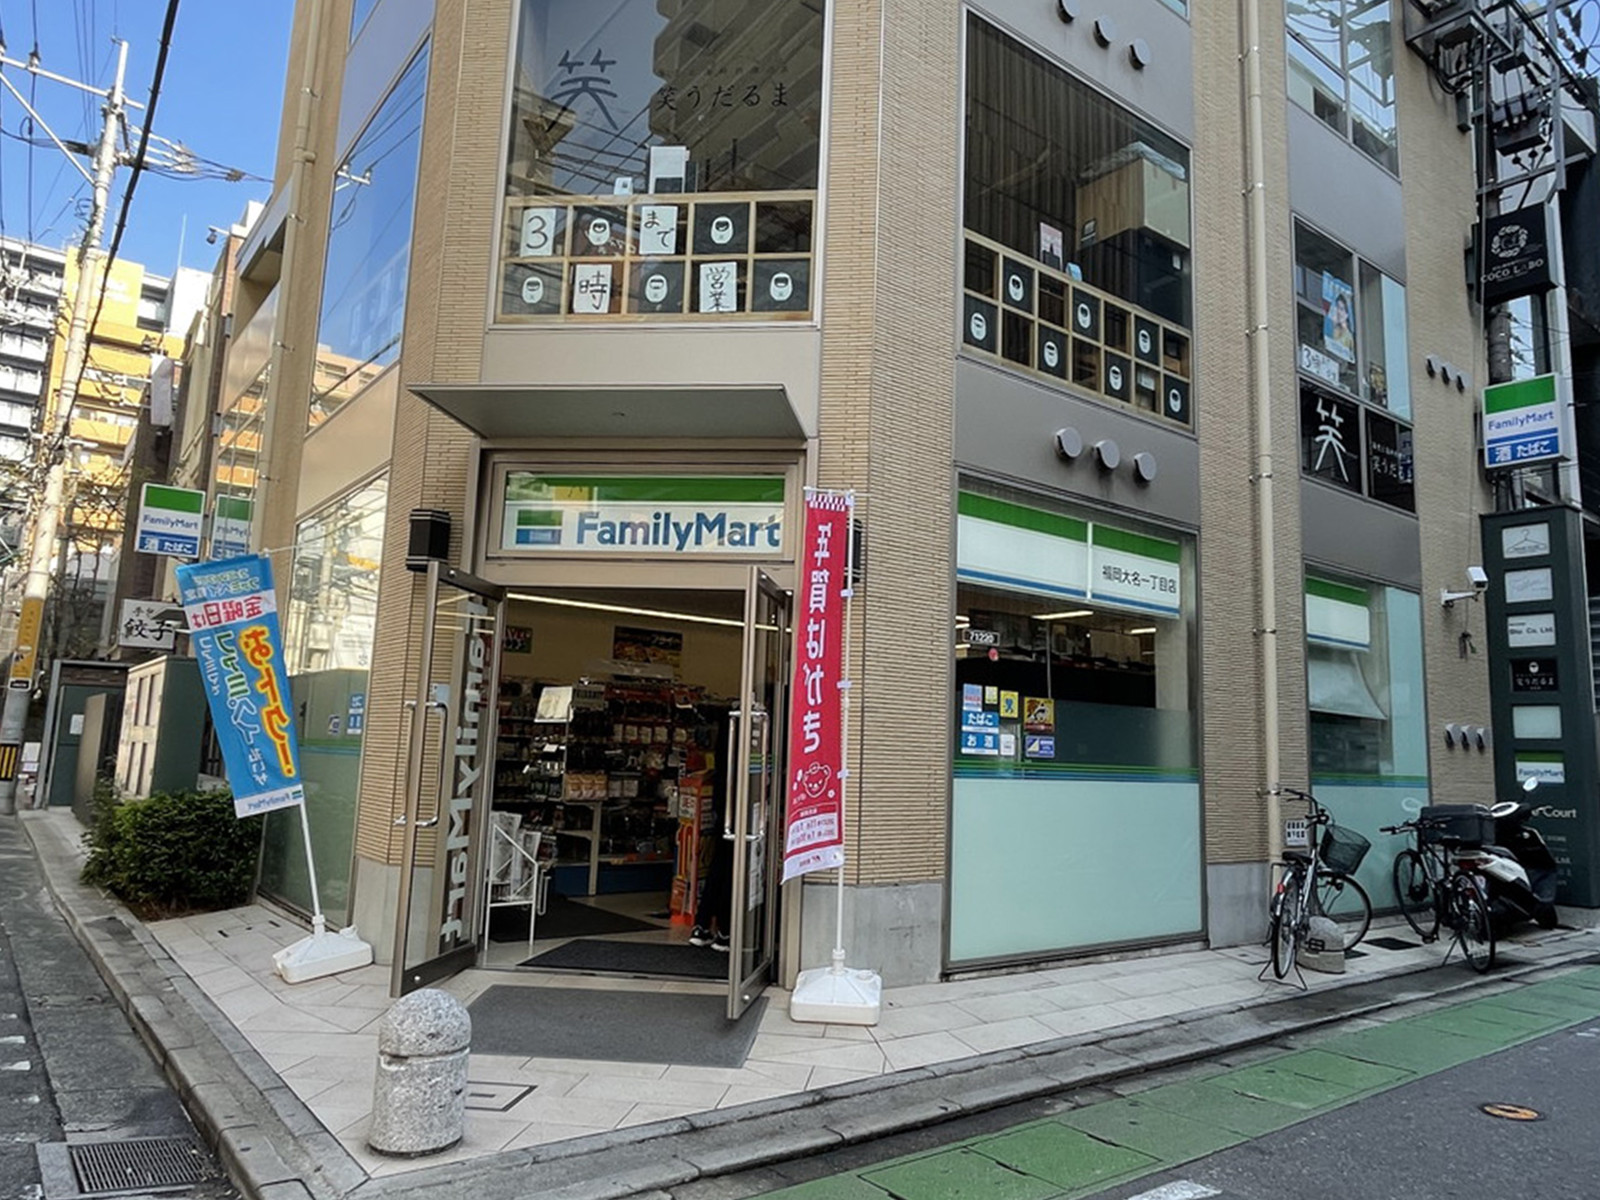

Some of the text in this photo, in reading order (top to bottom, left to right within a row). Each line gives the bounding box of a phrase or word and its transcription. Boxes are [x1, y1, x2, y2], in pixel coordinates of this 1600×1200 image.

[655, 82, 788, 111] 笑うだるま
[526, 209, 732, 311] 3 時 まで 営業
[1488, 410, 1555, 432] FamilyMart
[1516, 440, 1551, 458] たばこ
[143, 514, 198, 530] FamilyMart
[577, 511, 781, 551] FamilyMart
[163, 541, 193, 555] たばこ
[1102, 565, 1177, 594] 福岡大名一丁目店
[124, 618, 173, 641] 餃子
[967, 713, 994, 727] たばこ
[1518, 768, 1564, 779] FamilyMart
[1543, 806, 1577, 819] Court
